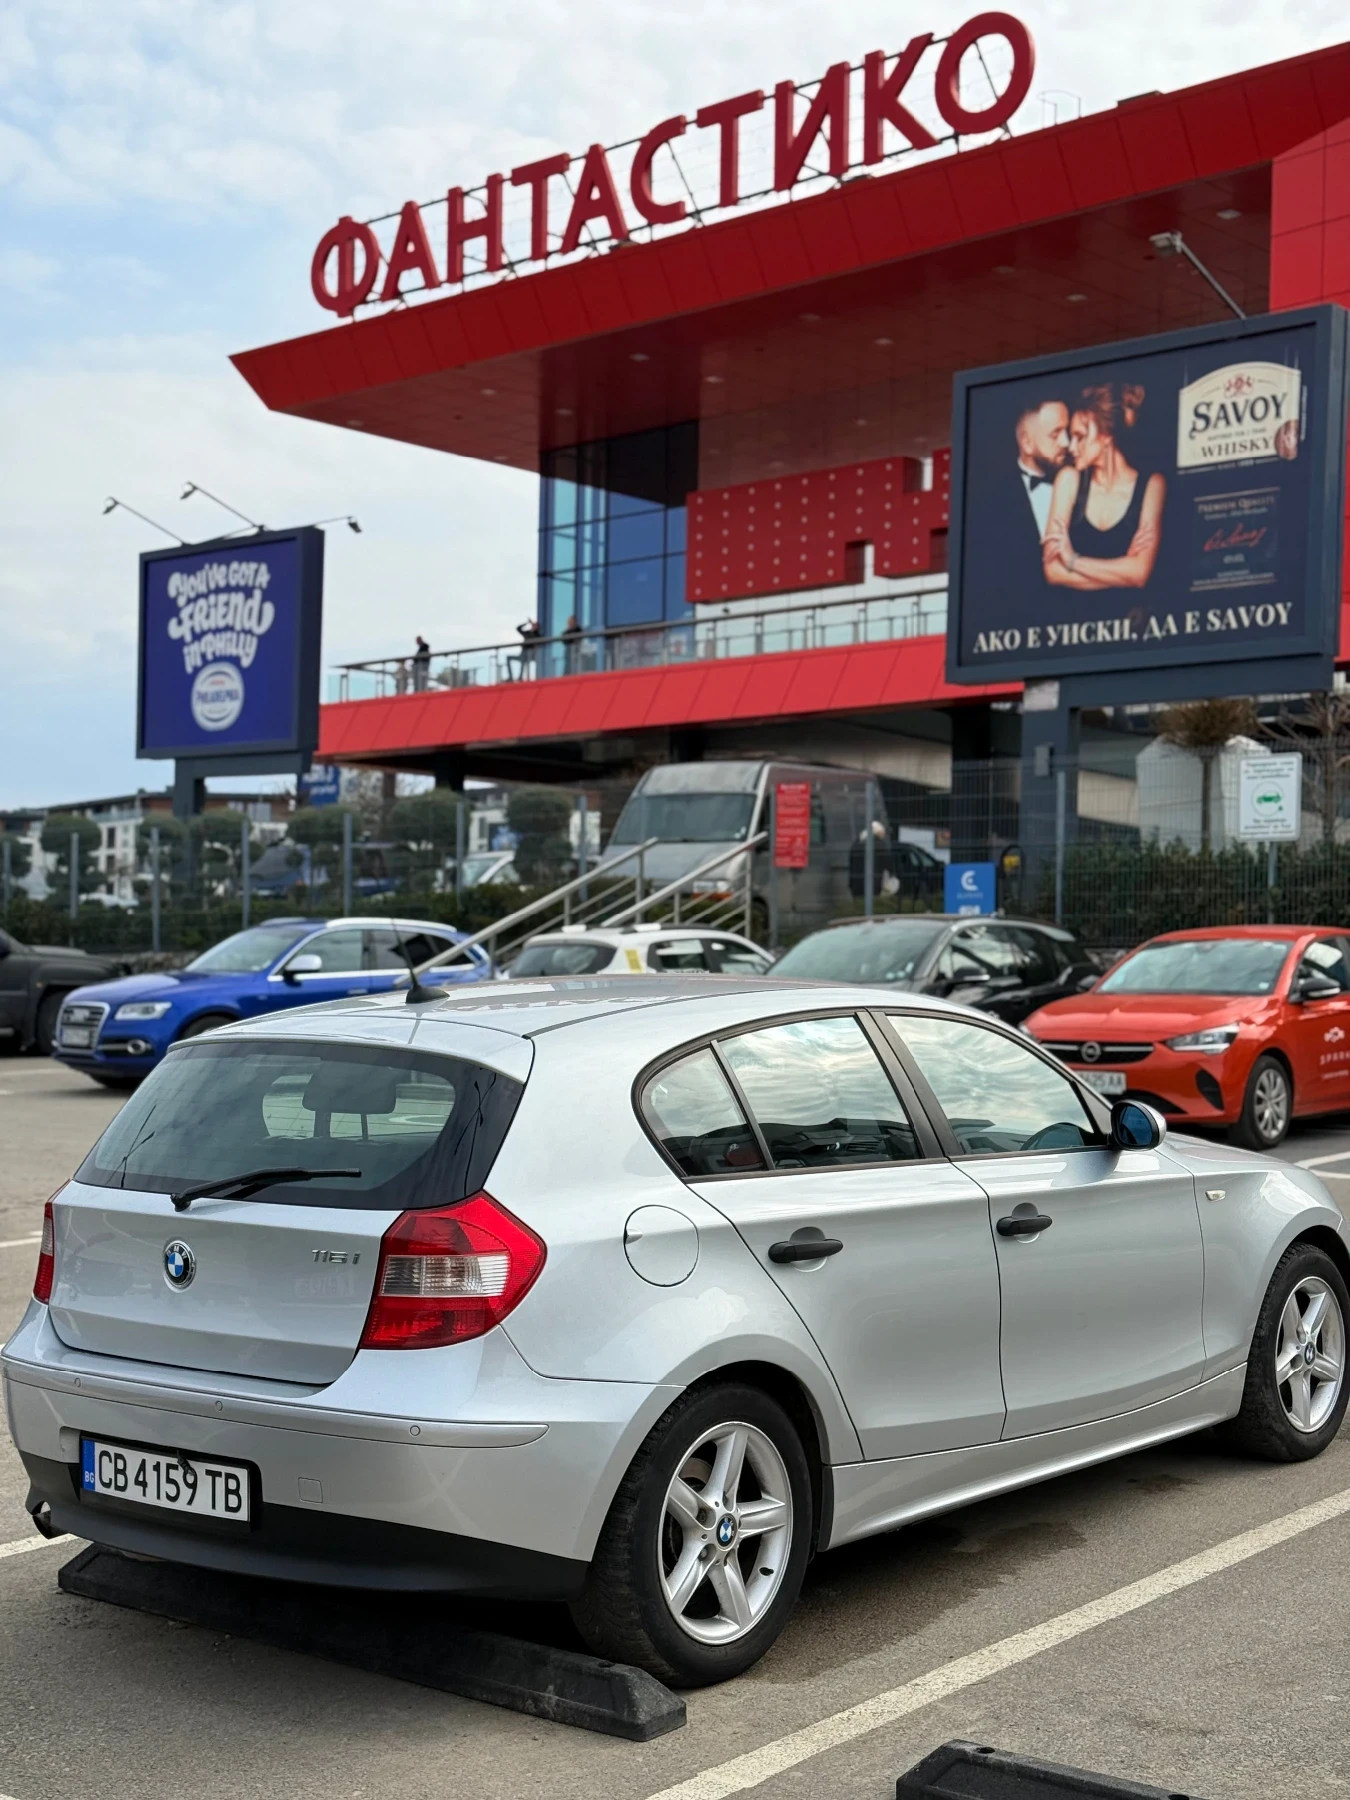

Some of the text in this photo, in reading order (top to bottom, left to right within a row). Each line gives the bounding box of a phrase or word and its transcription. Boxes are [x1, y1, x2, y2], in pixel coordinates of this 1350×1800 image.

[311, 11, 1036, 317] ФАНТАСТИКО
[1188, 392, 1288, 440] SAVOY
[1201, 436, 1271, 458] WHISKY
[972, 628, 1021, 654] АКО
[1142, 613, 1179, 643] ДА
[1205, 601, 1293, 632] SAVOY
[84, 1471, 95, 1483] BG
[98, 1450, 243, 1514] CB 4159 TB
